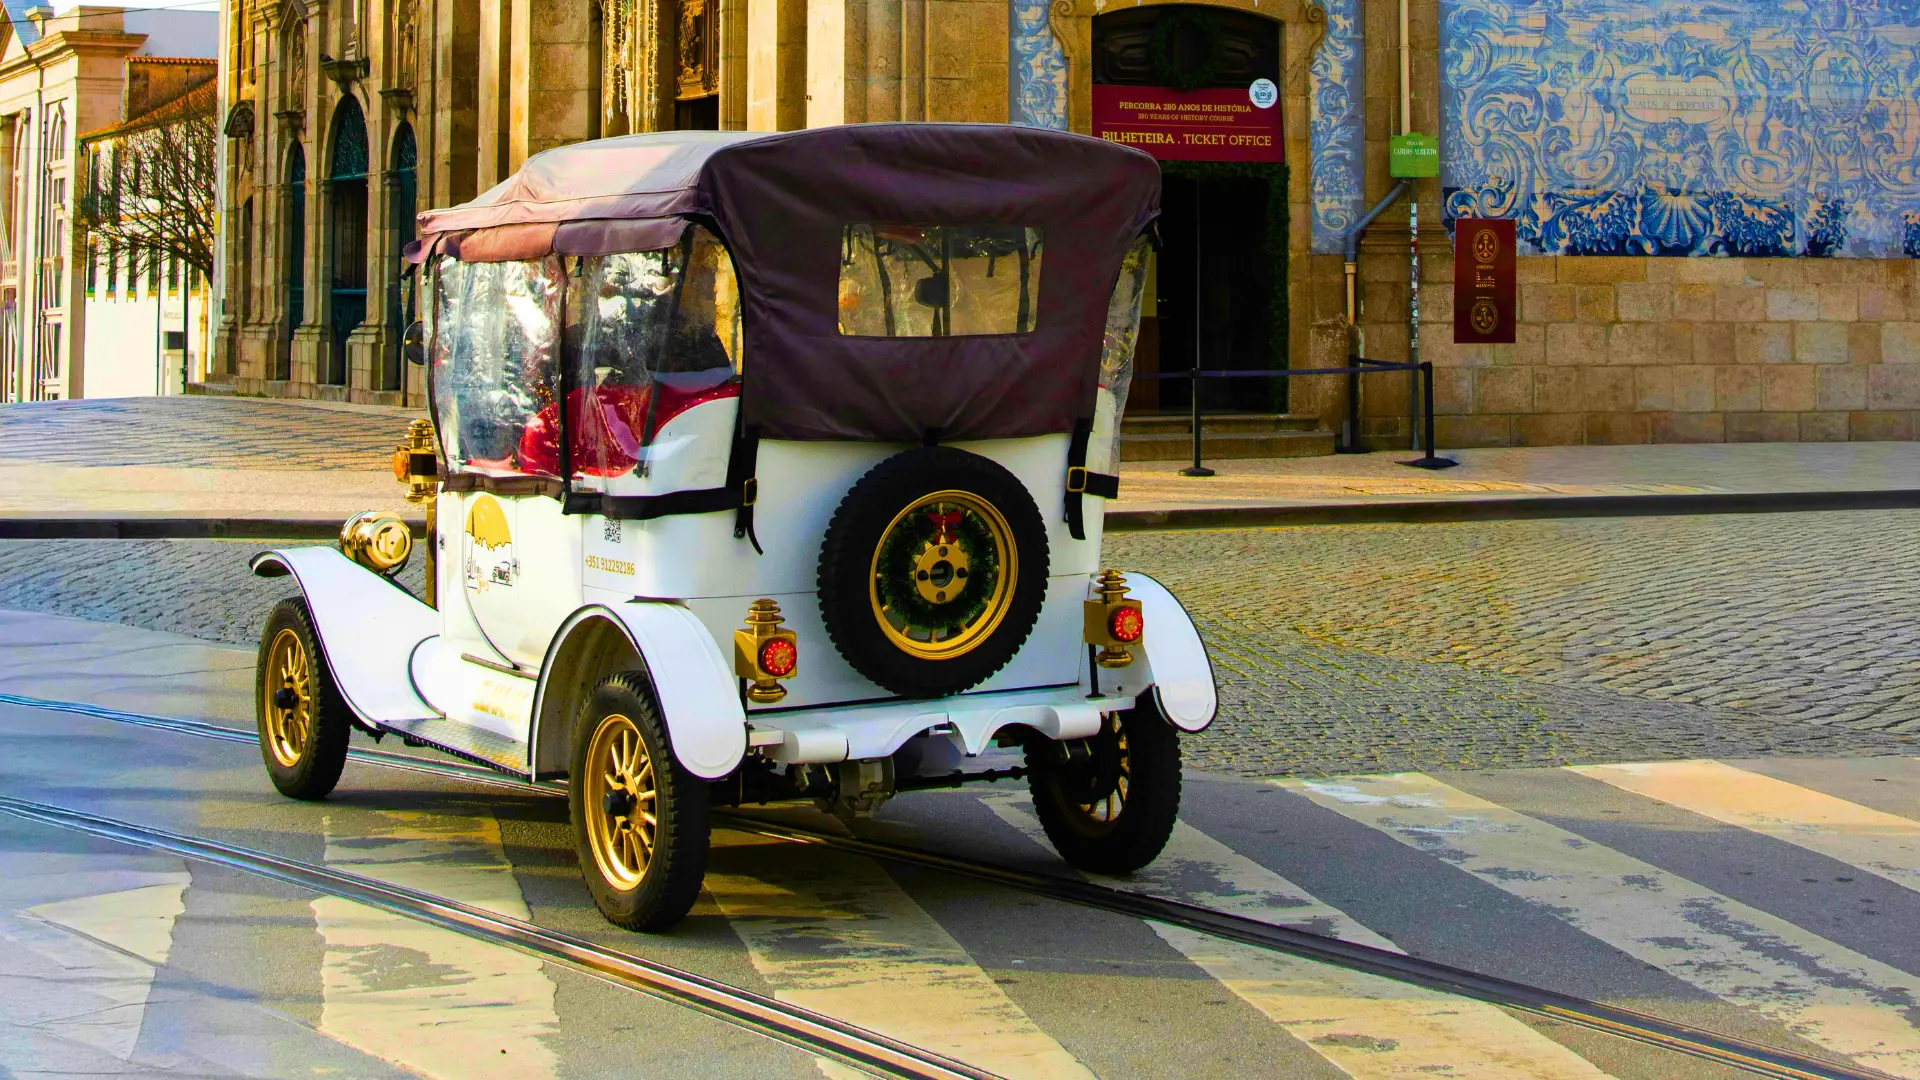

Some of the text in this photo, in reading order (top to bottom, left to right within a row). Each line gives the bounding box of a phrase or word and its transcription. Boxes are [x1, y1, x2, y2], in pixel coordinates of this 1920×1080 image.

[1119, 101, 1252, 113] PERCORRA 280 ANOS DE HISTÓRIA
[1181, 114, 1209, 122] HISTORY
[1102, 131, 1175, 144] BILHETEIRA
[1183, 133, 1227, 145] TICKET
[1228, 135, 1272, 146] OFFICE
[1393, 147, 1437, 156] CARLOS ALBERTO
[584, 554, 600, 570] +351
